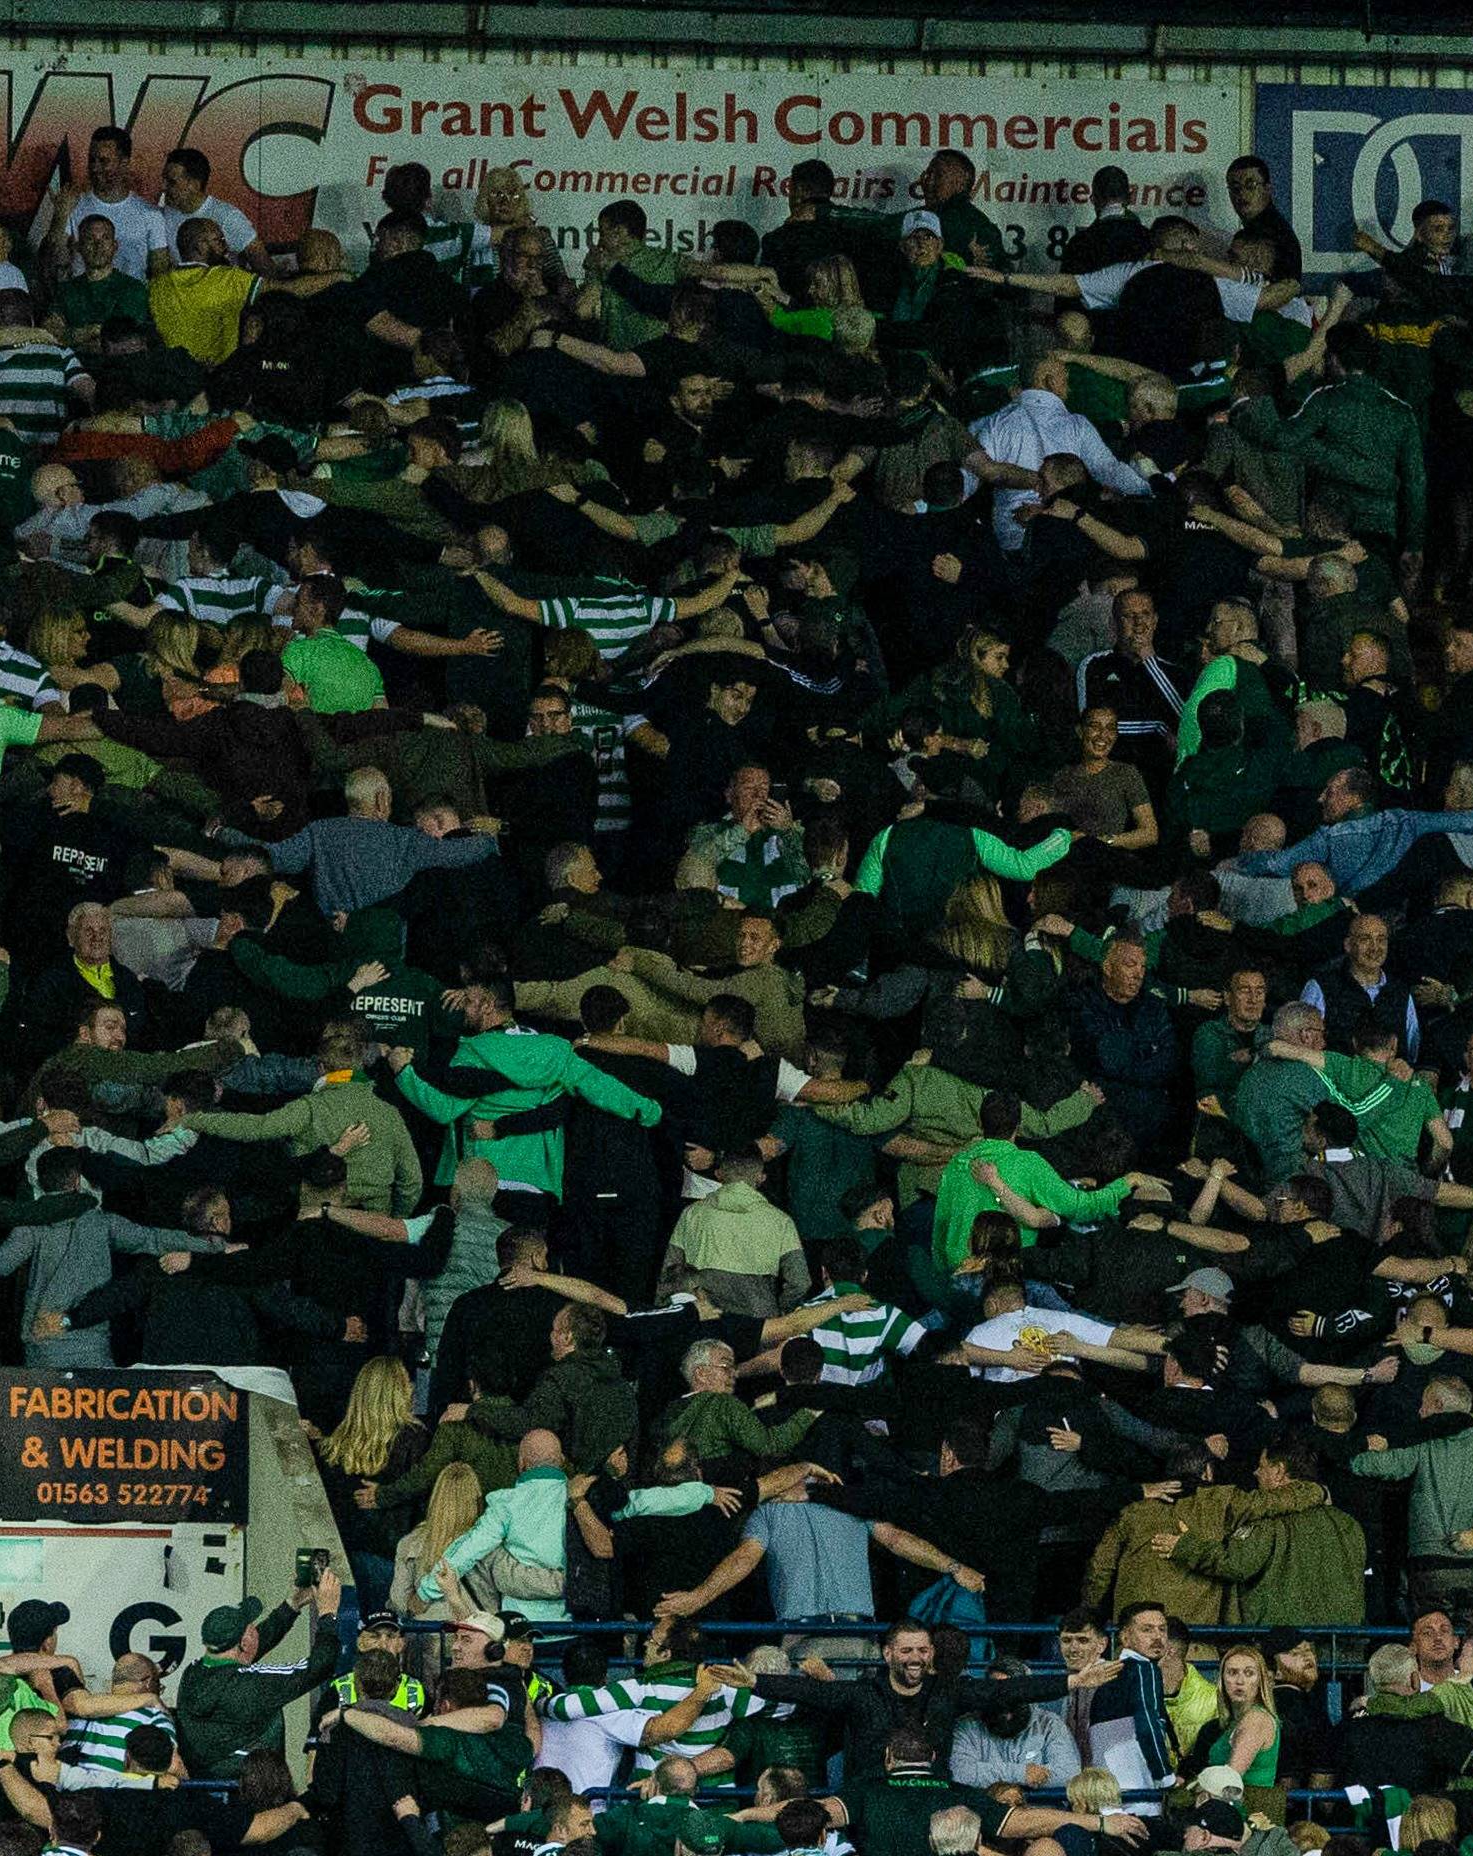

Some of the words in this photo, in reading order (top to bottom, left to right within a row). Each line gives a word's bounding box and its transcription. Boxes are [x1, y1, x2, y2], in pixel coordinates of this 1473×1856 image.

[353, 83, 545, 140] Grant
[560, 86, 758, 144] Welsh
[774, 93, 1208, 155] Commercials
[752, 164, 896, 202] Reairs
[970, 166, 1208, 208] Mainteance
[9, 1387, 239, 1424] FABRICATION
[21, 1440, 49, 1470] &
[60, 1436, 226, 1472] WELDING
[37, 1482, 112, 1504] 01563
[118, 1482, 211, 1506] 522774
[110, 1601, 186, 1670] G
